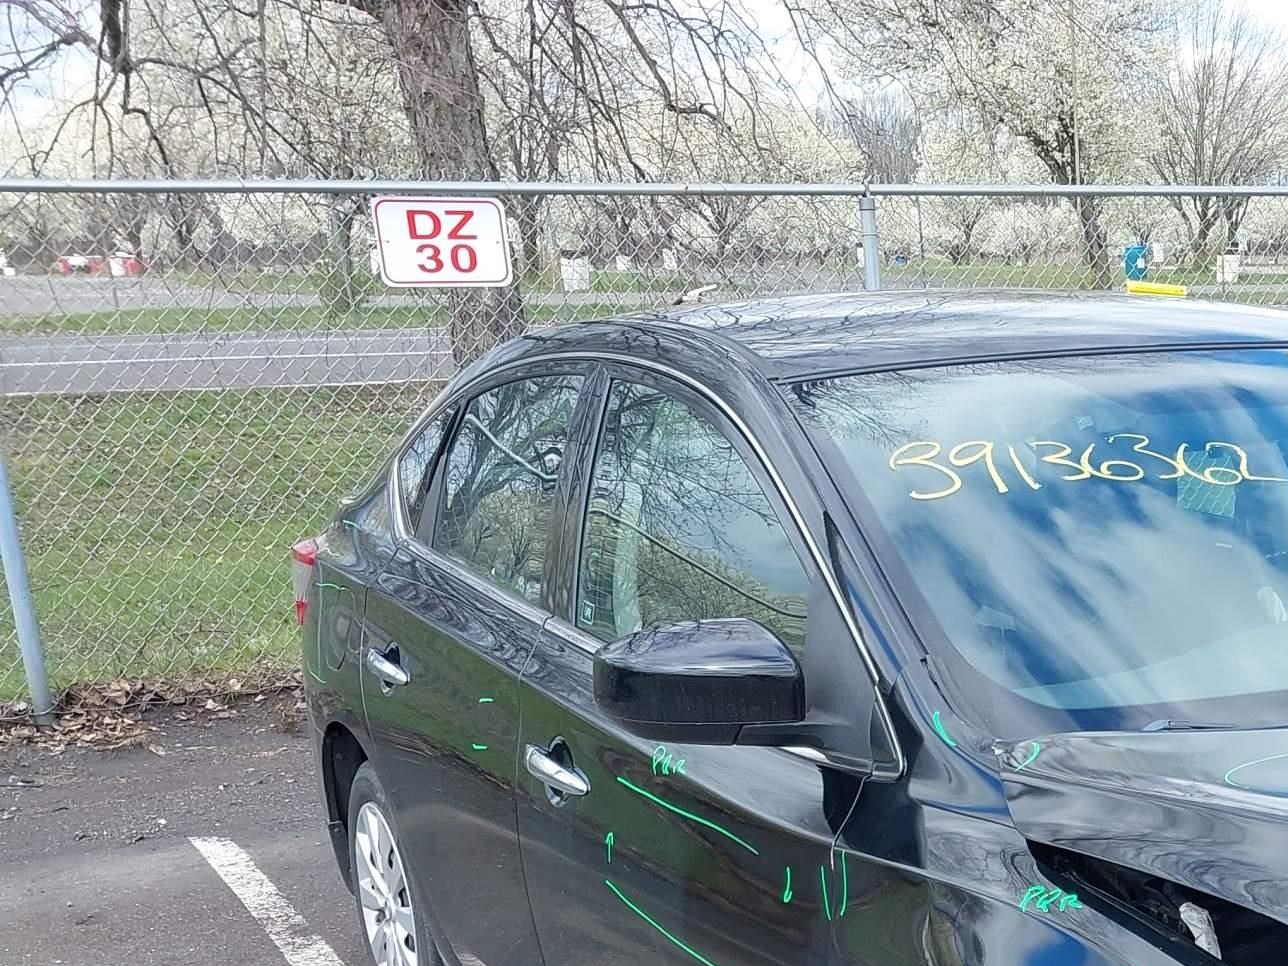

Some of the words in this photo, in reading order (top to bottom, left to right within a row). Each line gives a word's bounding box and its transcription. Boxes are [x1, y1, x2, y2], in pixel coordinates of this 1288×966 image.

[406, 209, 478, 240] DZ
[415, 243, 478, 274] 30
[889, 433, 1288, 500] 39136362
